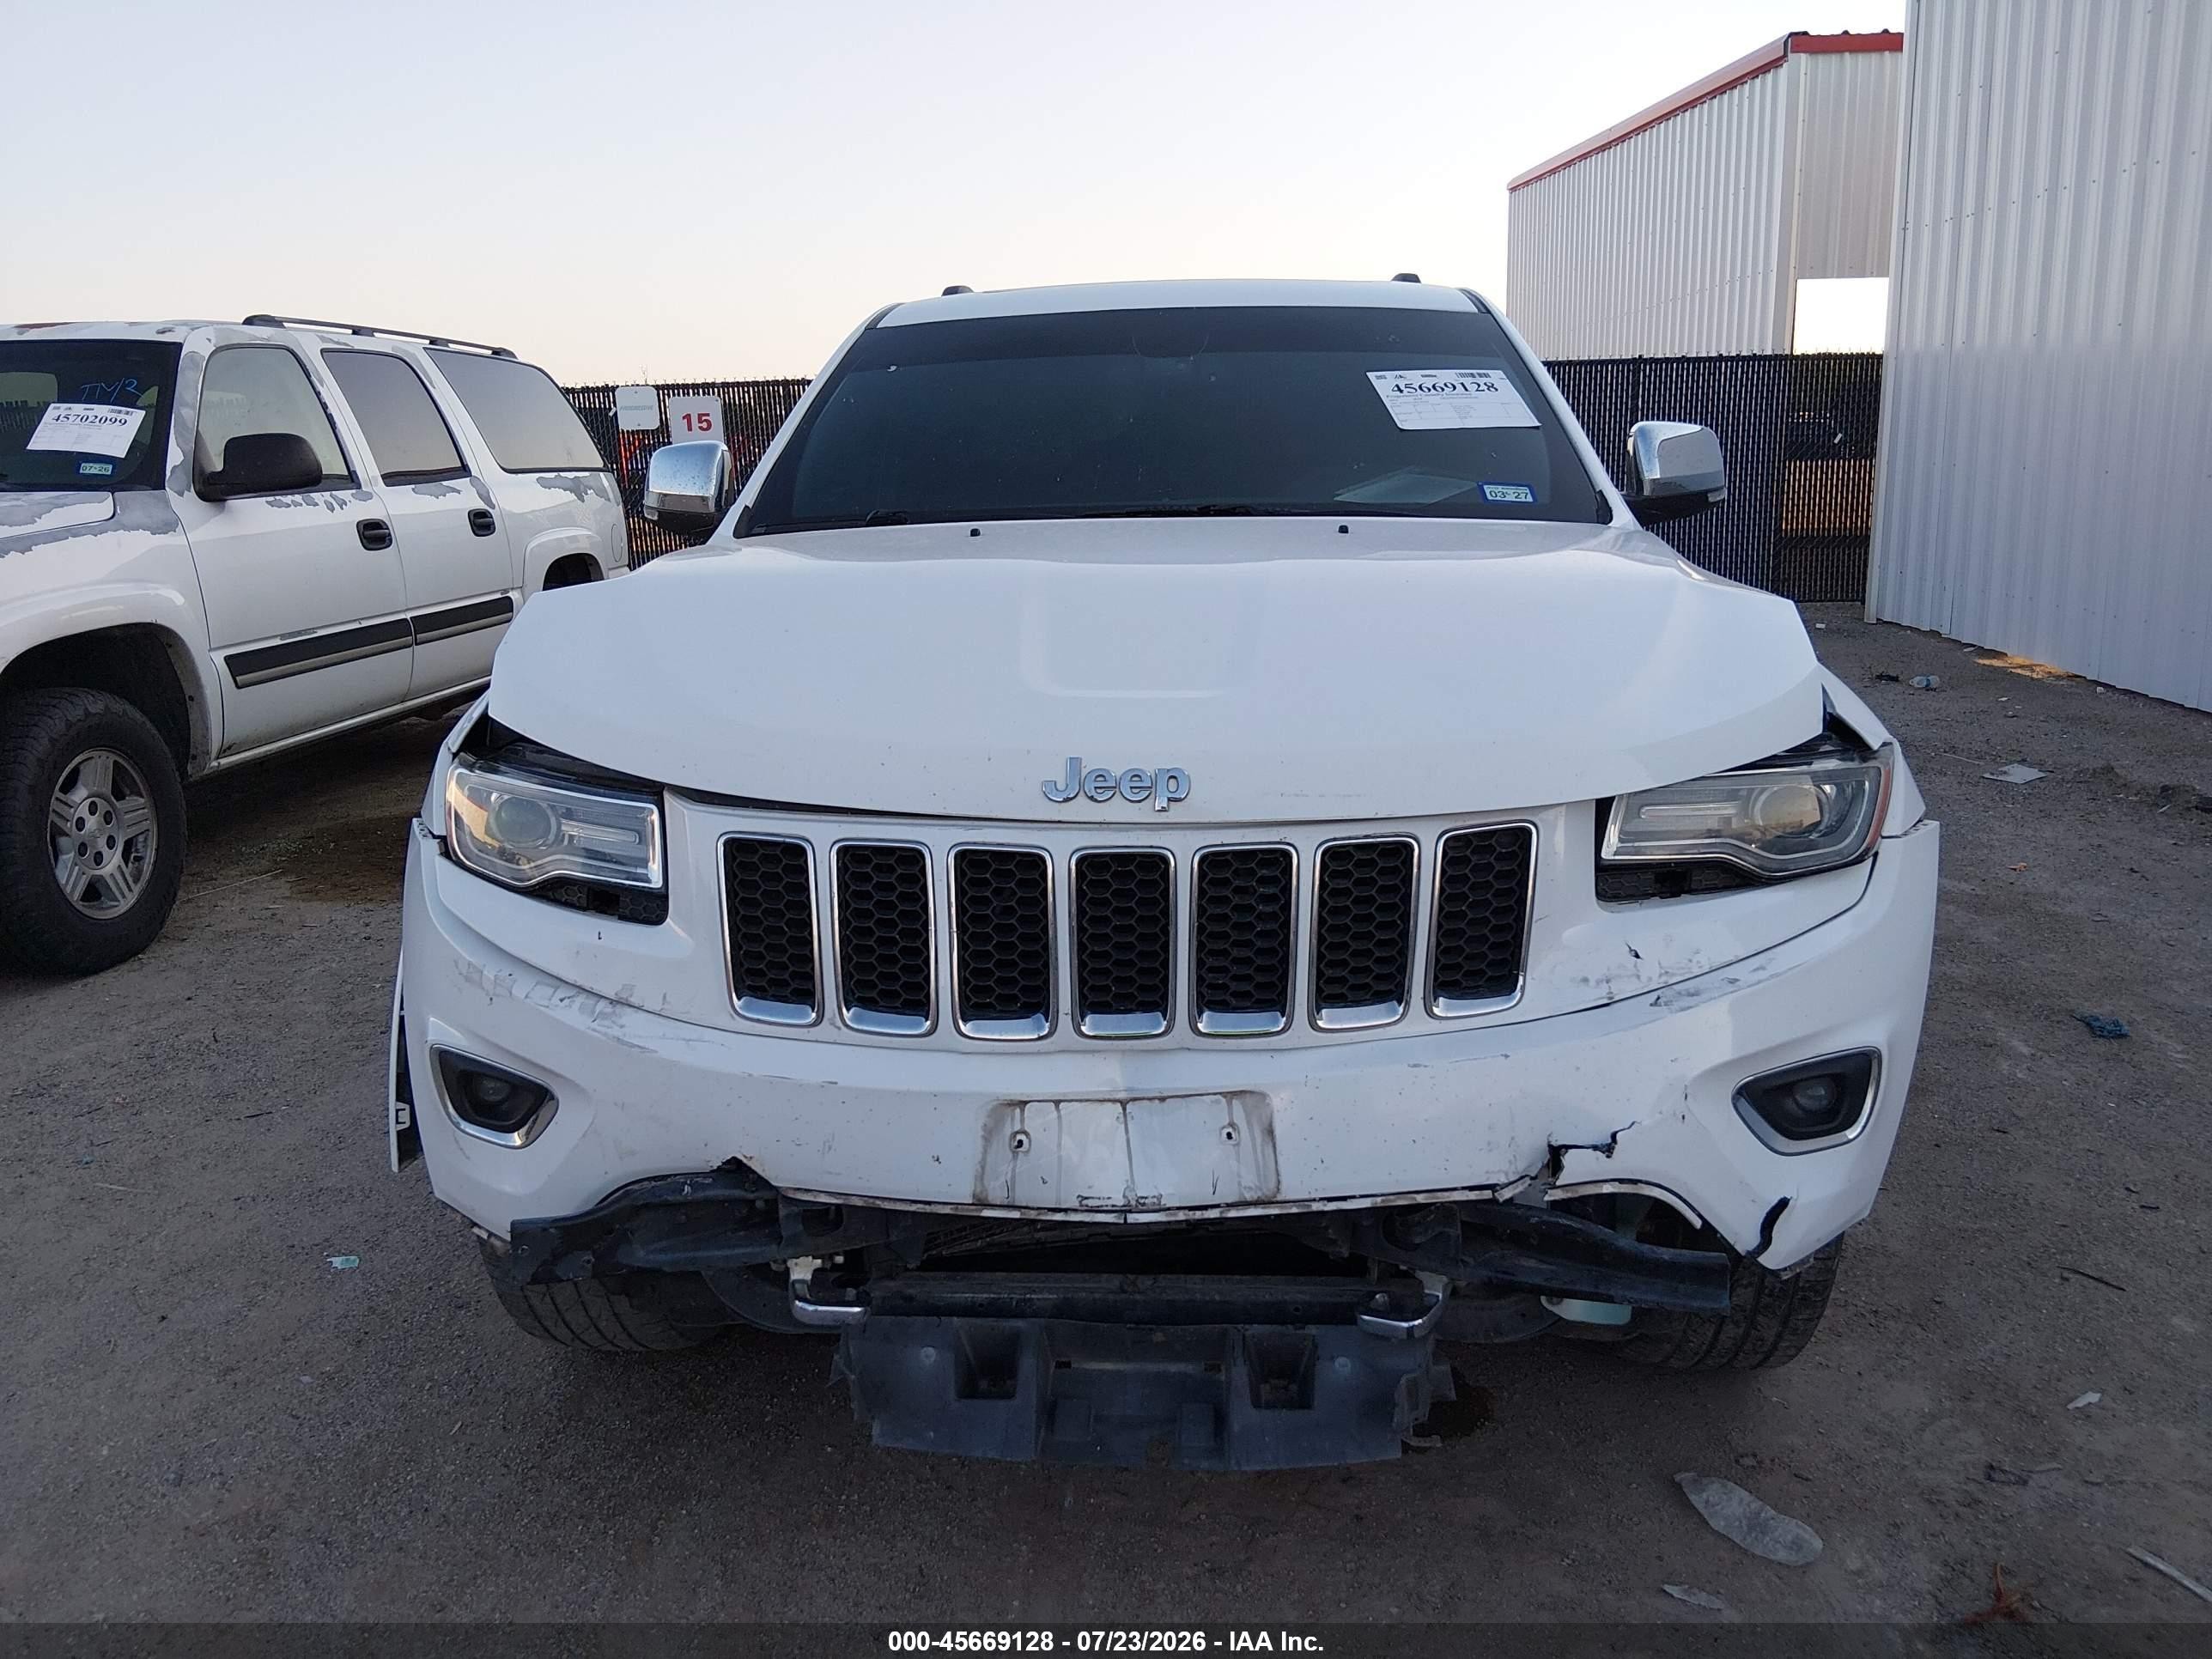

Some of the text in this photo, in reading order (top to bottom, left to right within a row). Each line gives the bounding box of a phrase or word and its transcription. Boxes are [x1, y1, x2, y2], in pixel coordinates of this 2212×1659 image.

[1391, 381, 1499, 394] 45669128
[52, 413, 128, 427] 45702099
[682, 412, 713, 432] 15
[1042, 756, 1191, 812] Jeep
